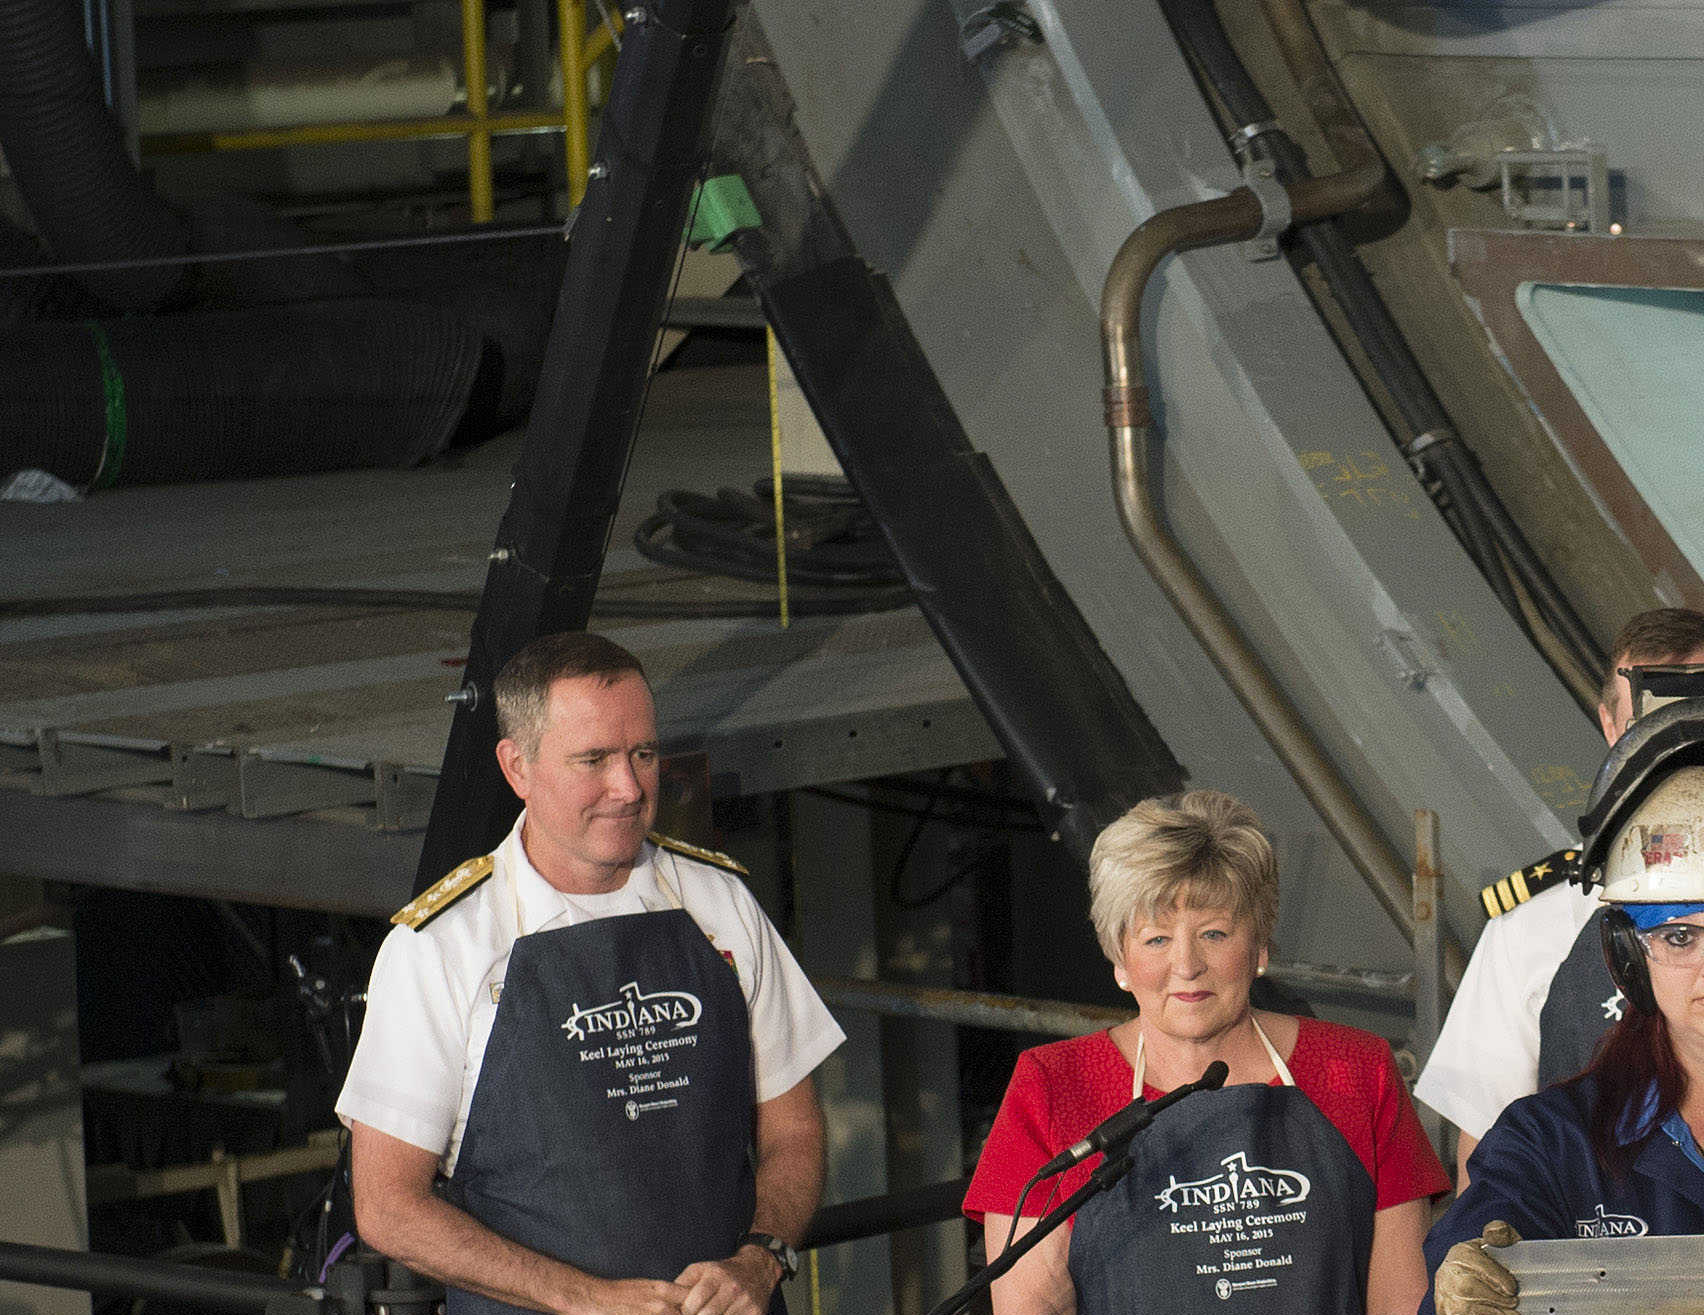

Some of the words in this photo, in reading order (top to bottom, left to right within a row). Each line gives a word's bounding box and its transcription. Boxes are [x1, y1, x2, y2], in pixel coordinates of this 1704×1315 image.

[584, 1000, 689, 1033] INDIANA
[616, 1028, 636, 1041] SSN
[639, 1026, 656, 1037] 789
[580, 1047, 605, 1062] Keel
[607, 1043, 643, 1059] Laying
[645, 1034, 698, 1052] Ceremony
[615, 1058, 636, 1069] MAY
[651, 1052, 670, 1063] 2015
[629, 1070, 661, 1083] Sponsor
[607, 1088, 628, 1099] Mrs.
[629, 1083, 655, 1095] Diane
[657, 1075, 689, 1090] Donald
[1180, 1171, 1295, 1206] INDIANA
[1213, 1202, 1236, 1214] SSN
[1240, 1199, 1260, 1210] 789
[1170, 1221, 1198, 1234] Keel
[1201, 1217, 1243, 1233] Laying
[1245, 1211, 1307, 1226] Ceremony
[1209, 1233, 1233, 1245] MAY
[1252, 1228, 1274, 1240] 2015
[1223, 1247, 1263, 1262] Sponsor
[1196, 1264, 1221, 1275] Mrs.
[1222, 1260, 1253, 1272] Diane
[1255, 1254, 1293, 1269] Donald
